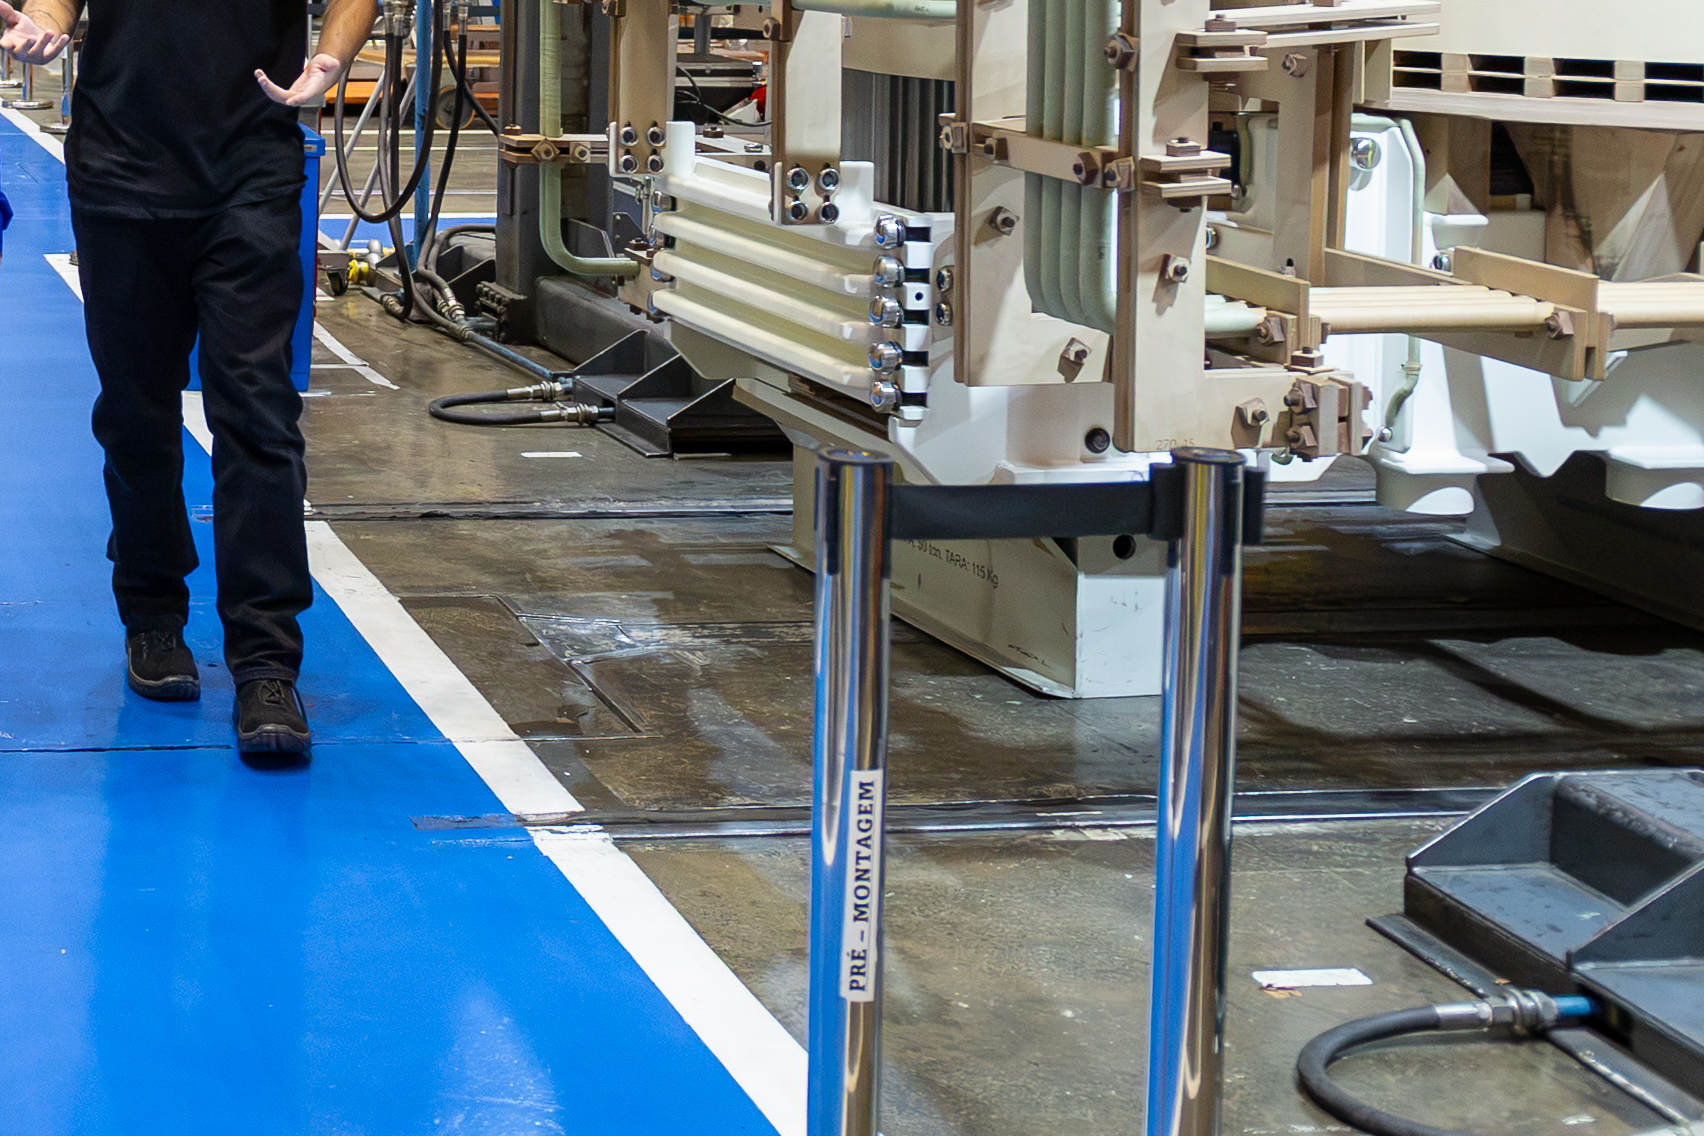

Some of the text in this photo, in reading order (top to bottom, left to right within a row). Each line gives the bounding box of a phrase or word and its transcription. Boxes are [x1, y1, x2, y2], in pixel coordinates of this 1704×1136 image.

[972, 562, 986, 580] 115
[852, 780, 875, 923] MONTAGEM
[847, 948, 867, 992] PRÉ
